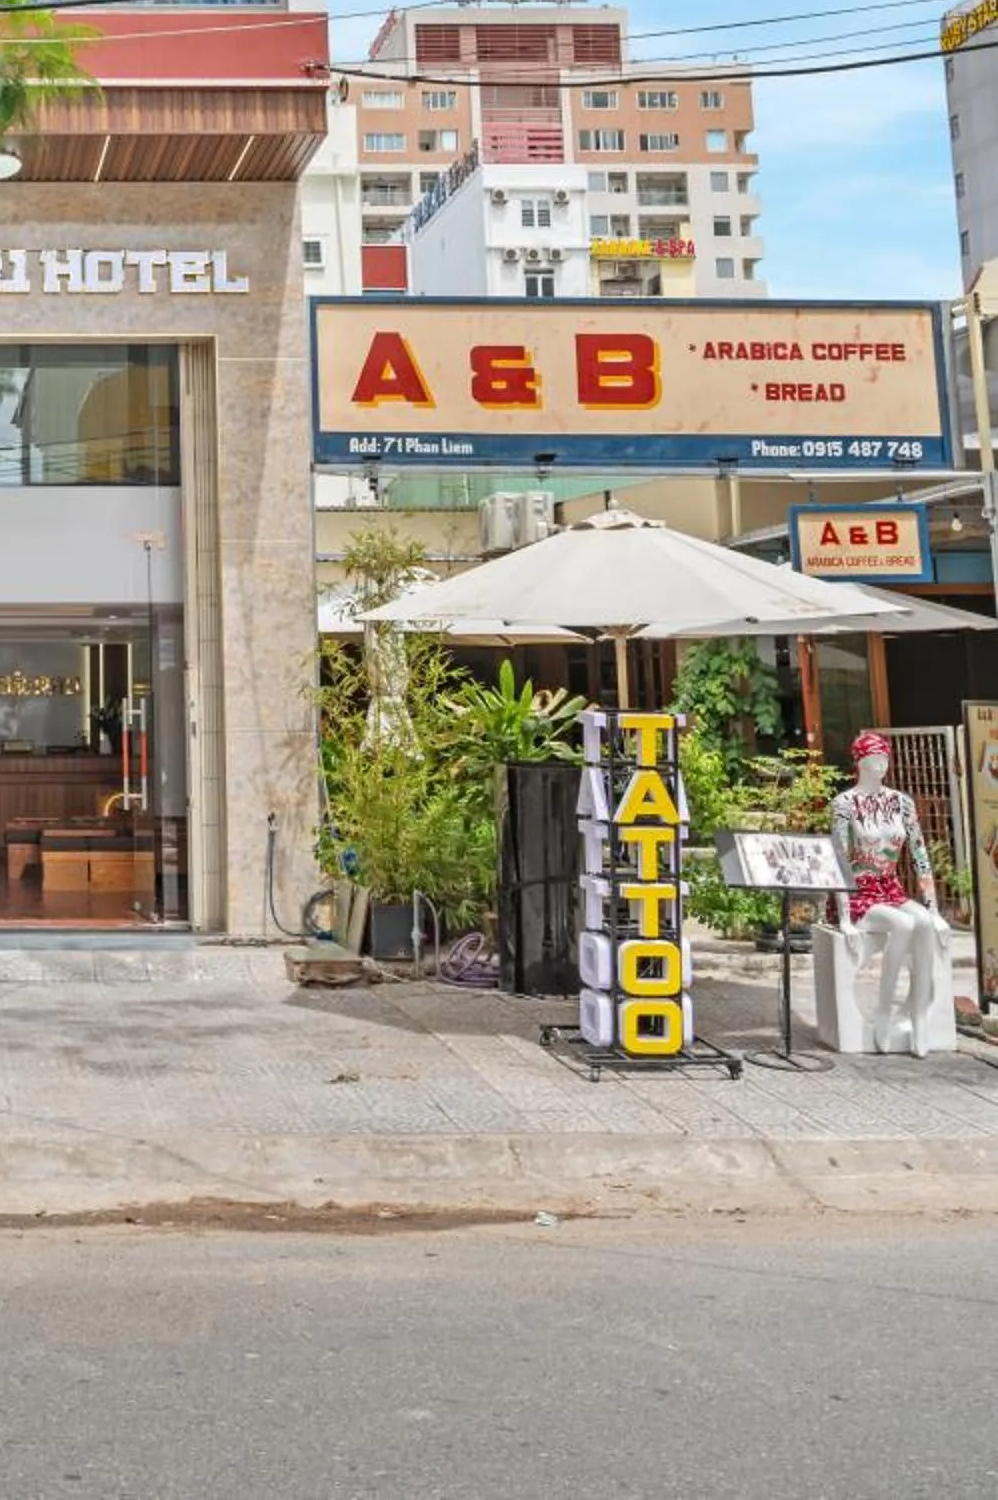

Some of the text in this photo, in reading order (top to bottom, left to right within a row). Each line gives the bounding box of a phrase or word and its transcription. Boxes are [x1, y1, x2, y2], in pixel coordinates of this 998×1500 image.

[40, 248, 249, 293] HOTEL
[811, 342, 907, 362] COFFEE
[351, 331, 663, 410] A & B
[765, 383, 846, 402] BREAD
[349, 437, 382, 454] Add:
[405, 437, 440, 454] Phan
[441, 438, 474, 455] Liem
[803, 441, 843, 457] 0915
[848, 441, 882, 457] 487
[887, 441, 923, 458] 748
[820, 521, 899, 546] A & B
[614, 713, 683, 1056] TATTOO
